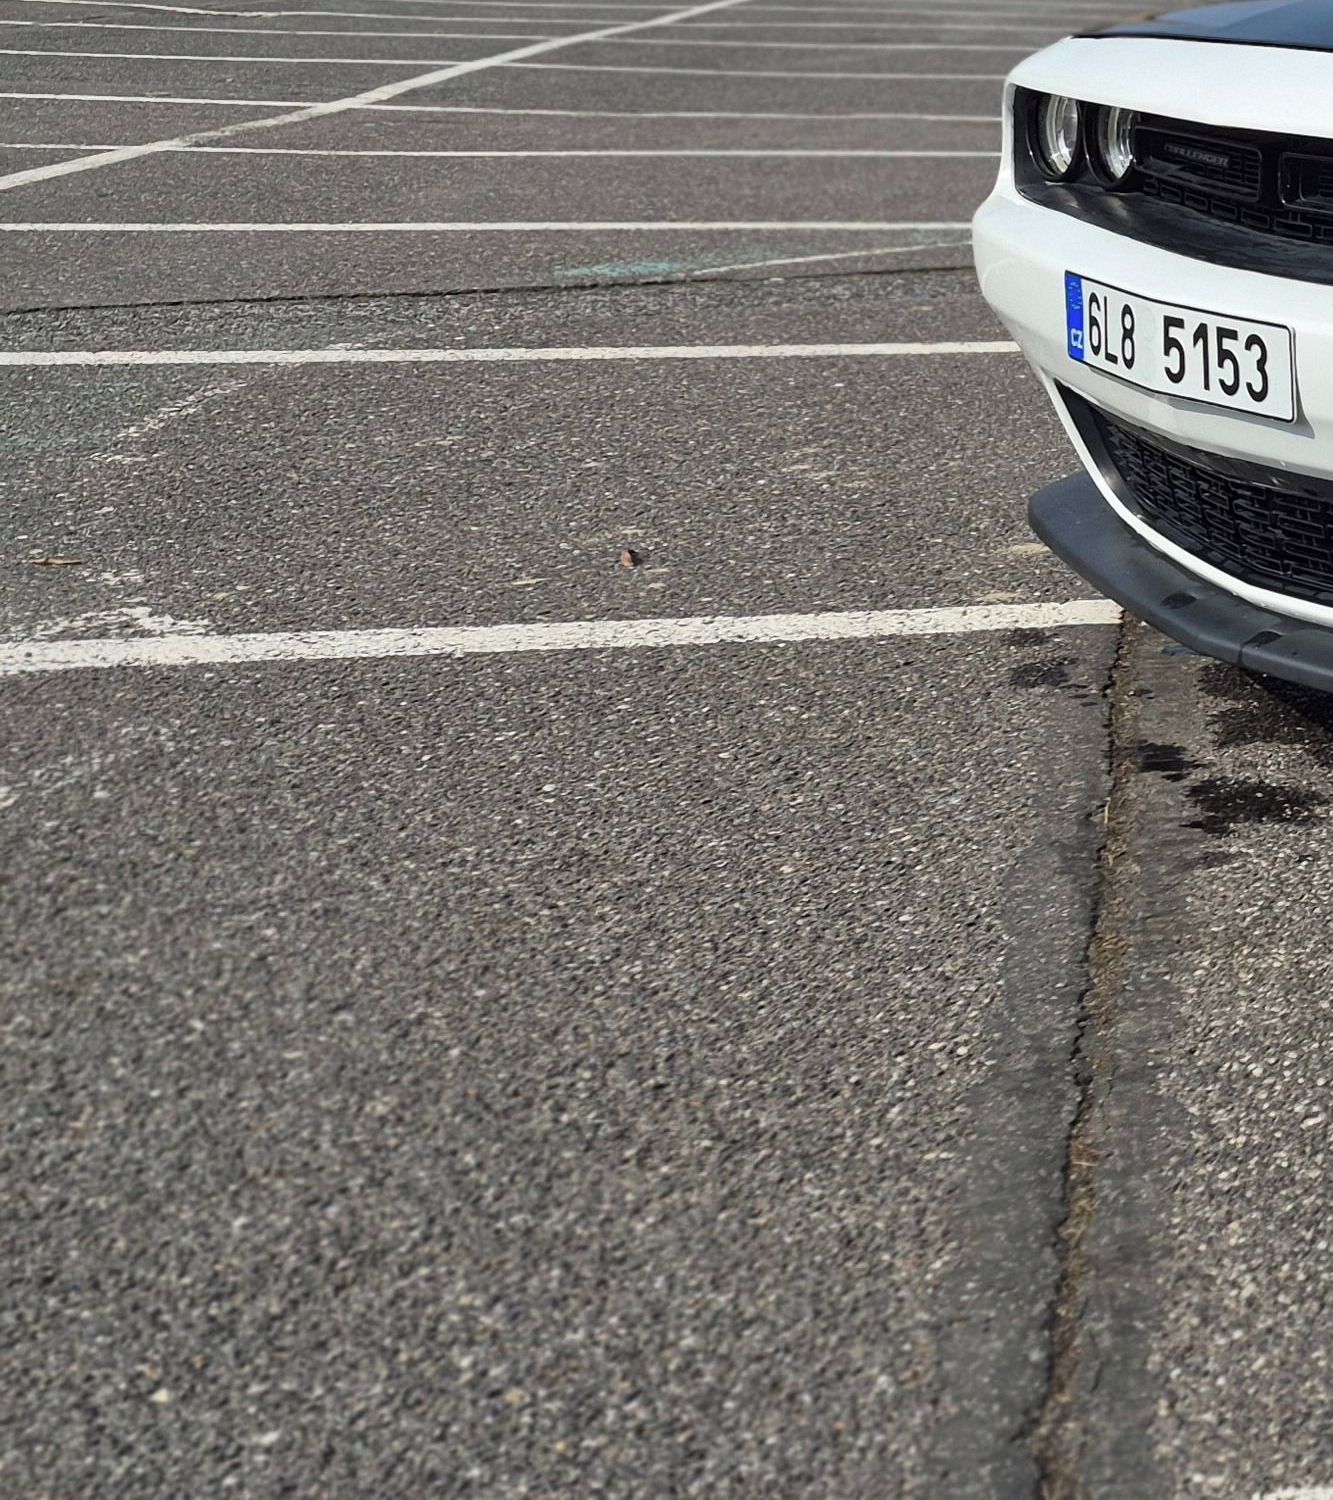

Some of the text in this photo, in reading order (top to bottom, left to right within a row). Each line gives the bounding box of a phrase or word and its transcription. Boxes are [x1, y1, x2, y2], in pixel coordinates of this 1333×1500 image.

[1070, 328, 1083, 349] CZ
[1088, 291, 1269, 403] 6L8 5153
